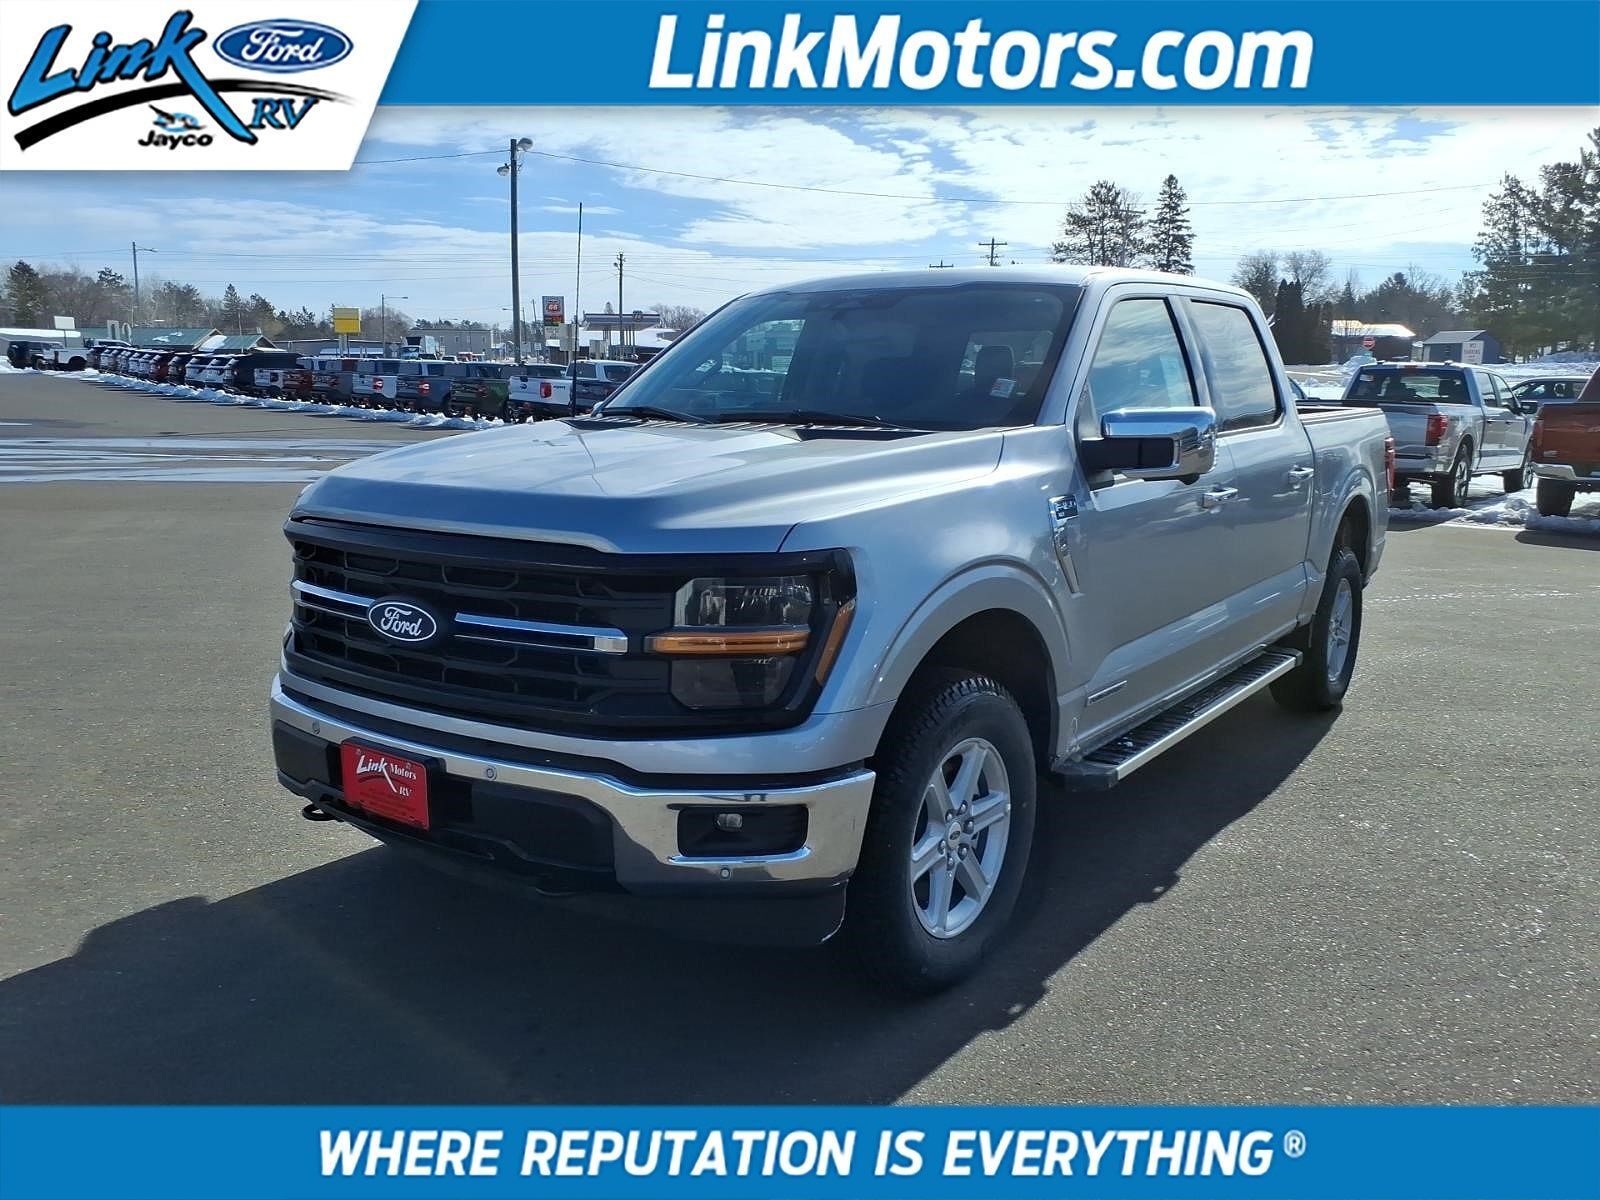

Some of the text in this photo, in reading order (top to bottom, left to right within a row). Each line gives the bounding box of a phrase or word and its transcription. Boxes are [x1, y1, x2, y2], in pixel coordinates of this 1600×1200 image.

[380, 606, 423, 637] Ford
[356, 754, 417, 793] Link Motors
